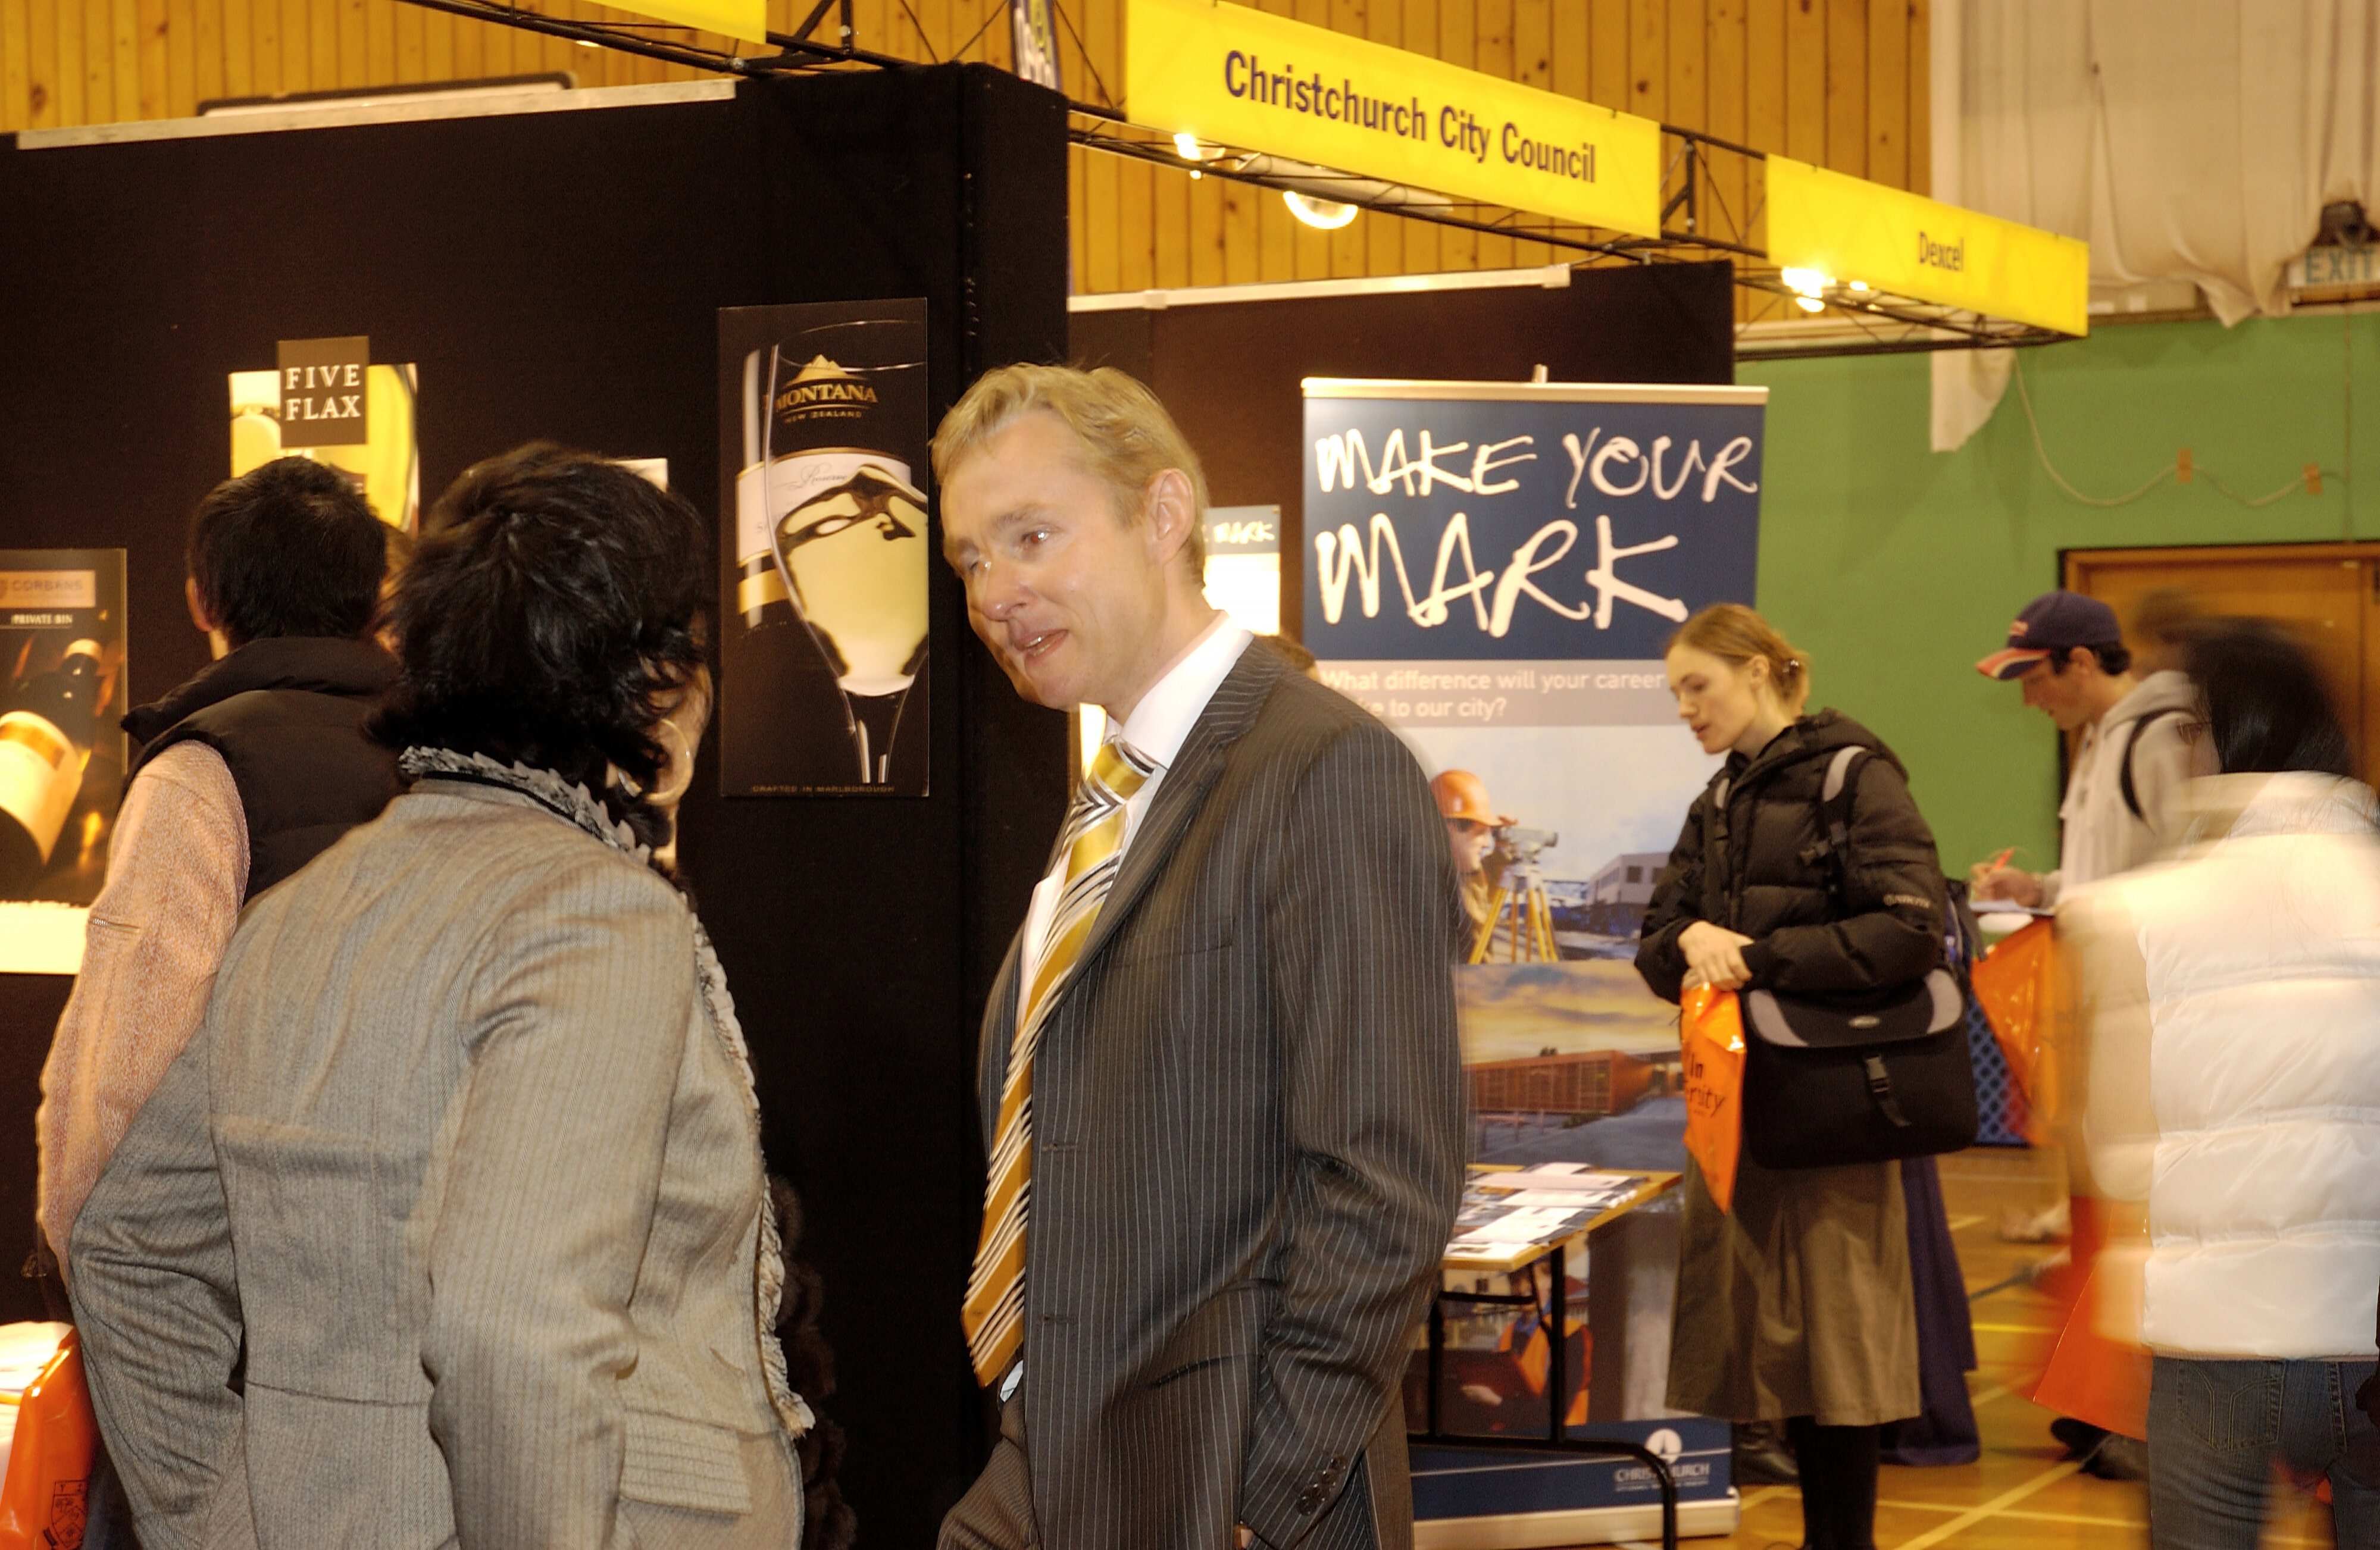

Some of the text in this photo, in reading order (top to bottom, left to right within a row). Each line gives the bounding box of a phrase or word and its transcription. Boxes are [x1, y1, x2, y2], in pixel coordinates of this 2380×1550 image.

[1224, 50, 1596, 183] Christchurch City Council
[1918, 231, 1965, 273] Dexcel
[2305, 249, 2375, 283] EXIT
[285, 364, 360, 390] FIVE
[285, 395, 361, 421] FLAX
[774, 383, 879, 413] MONTANA
[1315, 426, 1759, 509] MAKE YOUR
[1212, 520, 1275, 545] MARK
[12, 578, 83, 592] CORBANS
[1314, 512, 1689, 638] MARK
[1319, 669, 1666, 694] What difference will your career
[1388, 698, 1411, 718] to
[1415, 701, 1455, 718] our
[1458, 696, 1508, 722] city?
